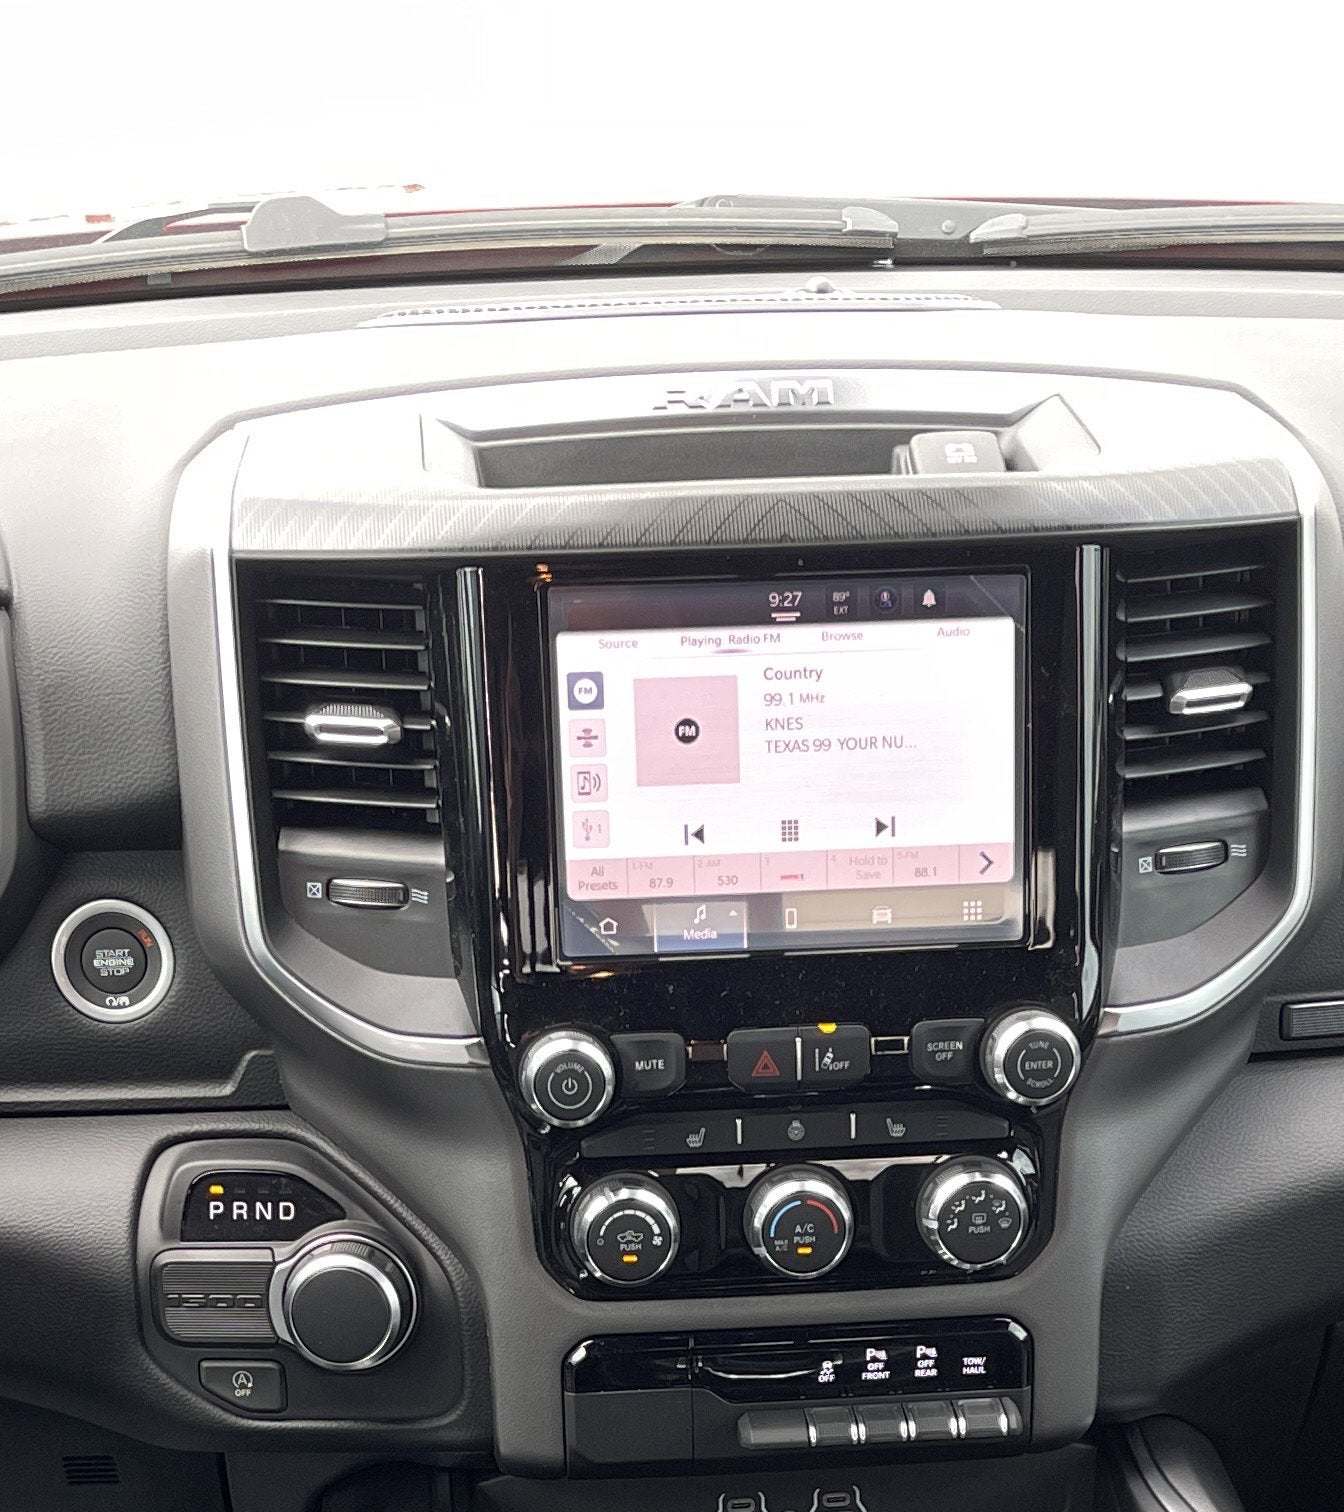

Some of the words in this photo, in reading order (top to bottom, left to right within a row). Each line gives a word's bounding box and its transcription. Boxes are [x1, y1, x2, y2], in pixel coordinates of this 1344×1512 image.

[652, 378, 835, 410] RAM
[768, 591, 802, 607] 9:27
[833, 606, 848, 615] EXT
[821, 631, 864, 642] Browse
[936, 627, 970, 637] Audio
[598, 639, 638, 649] Source
[680, 635, 722, 648] Playing
[728, 634, 760, 645] Radio
[763, 633, 781, 643] FM
[763, 667, 823, 682] Country
[578, 687, 593, 695] FM
[799, 693, 825, 704] MHz
[765, 717, 804, 731] KNES
[678, 725, 697, 737] FM
[765, 739, 809, 754] TEXAS
[812, 738, 831, 752] 99
[837, 736, 878, 751] YOUR
[848, 855, 875, 866] Hold
[876, 856, 888, 866] to
[590, 866, 604, 877] All
[856, 869, 882, 880] Save
[578, 880, 618, 891] Presets
[648, 877, 674, 889] 87.9
[717, 875, 738, 886] 530
[683, 928, 717, 940] Media
[95, 948, 131, 959] START
[93, 957, 135, 967] ENGINE
[100, 967, 130, 977] STOP
[927, 1041, 963, 1052] SCREEN
[1028, 1040, 1050, 1051] TUNE
[935, 1051, 953, 1062] OFF
[556, 1061, 585, 1074] VOLUME
[635, 1059, 665, 1071] MUTE
[832, 1060, 850, 1070] OFF
[1025, 1060, 1053, 1070] ENTER
[1026, 1077, 1054, 1089] SCROLL
[795, 1223, 815, 1234] A/C
[968, 1225, 991, 1234] PUSH
[793, 1236, 816, 1244] PUSH
[620, 1243, 642, 1251] PUSH
[867, 1362, 885, 1371] OFF
[917, 1360, 935, 1369] OFF
[962, 1365, 986, 1375] HAUL
[818, 1374, 835, 1383] OFF
[862, 1371, 890, 1380] FRONT
[914, 1368, 938, 1378] REAR
[235, 1388, 251, 1397] OFF
